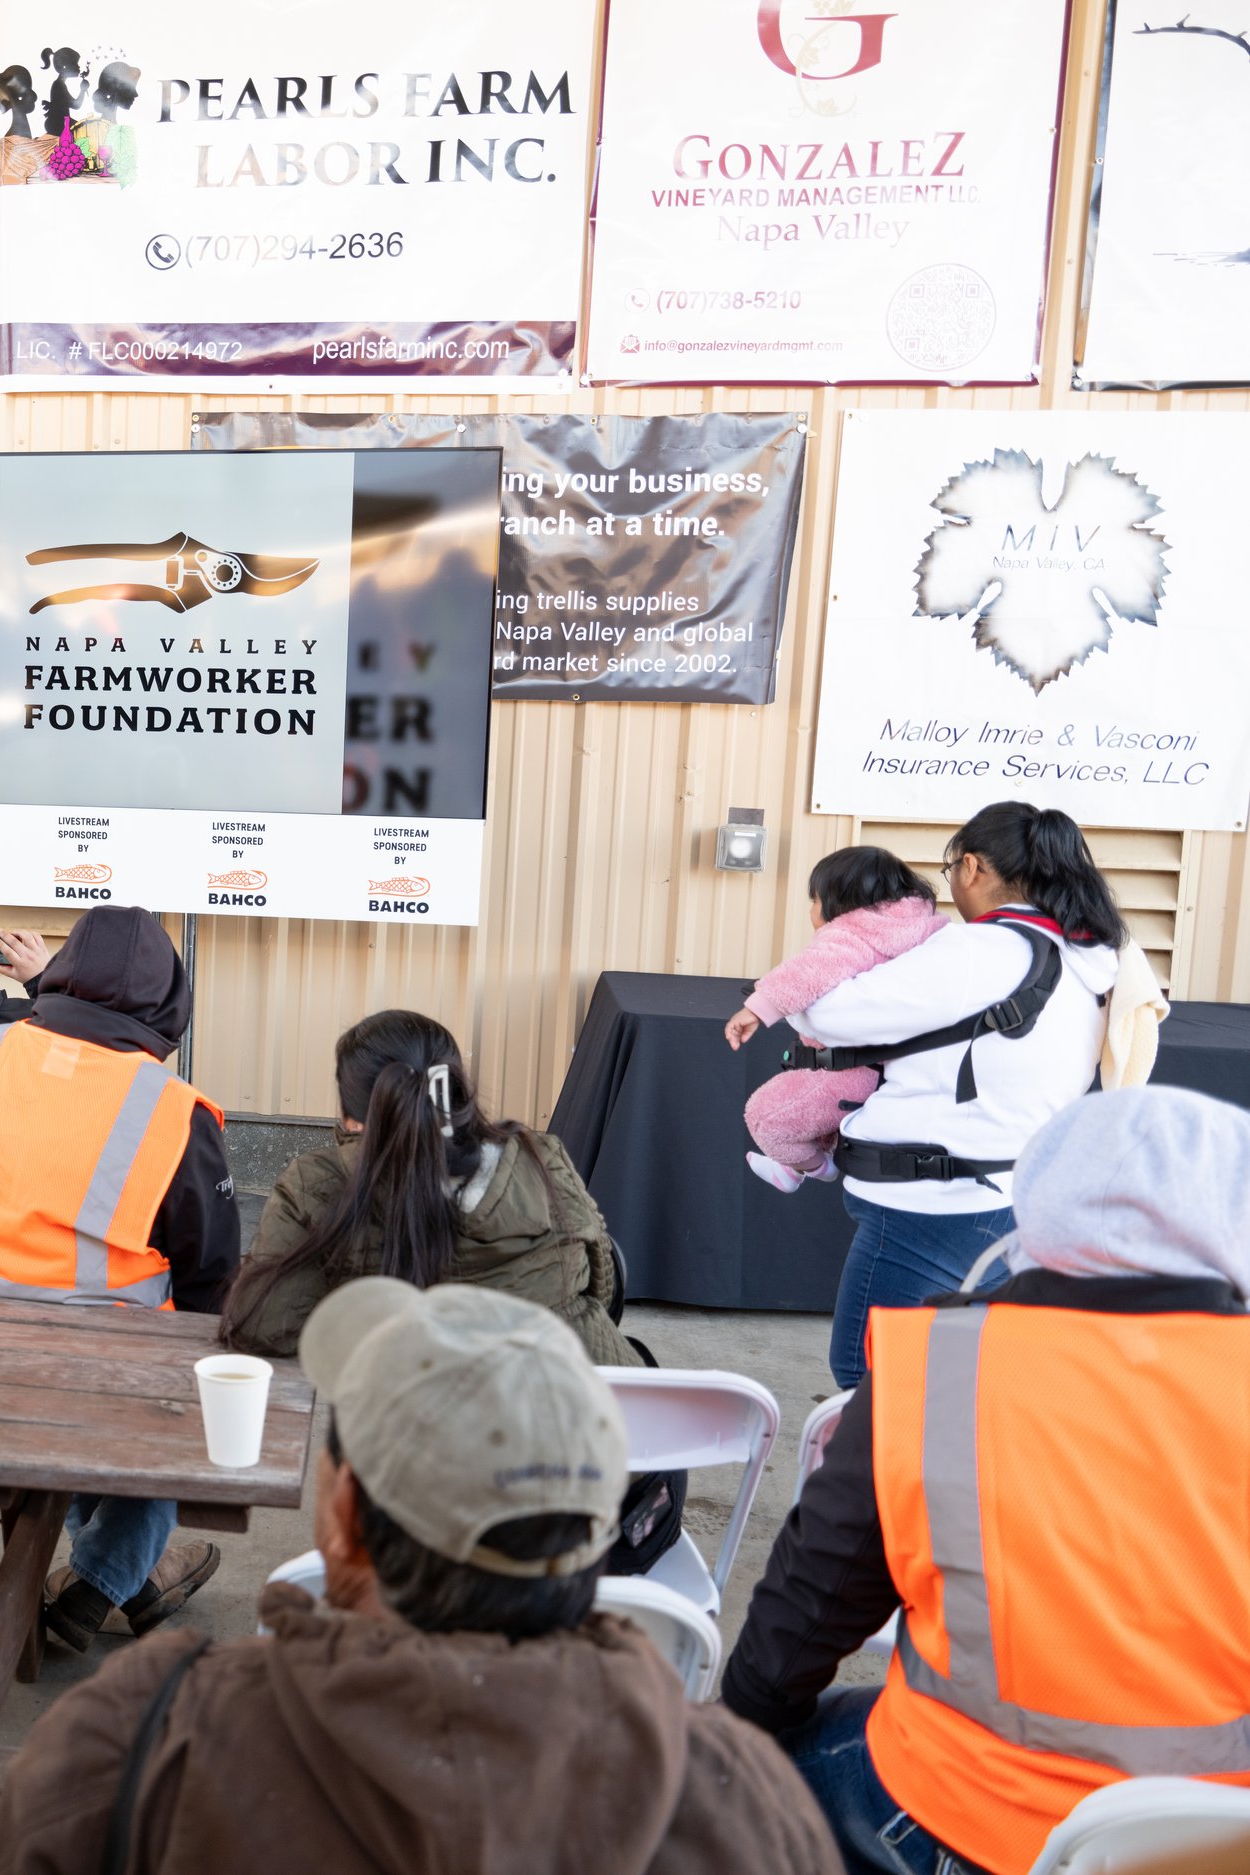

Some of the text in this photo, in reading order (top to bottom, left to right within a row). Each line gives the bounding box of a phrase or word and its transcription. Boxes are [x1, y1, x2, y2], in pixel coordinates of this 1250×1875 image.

[156, 69, 578, 123] PEARLS FARM
[193, 137, 556, 188] LABOR INC.
[673, 131, 966, 181] GONZALEZ
[651, 187, 770, 207] VINEYARD
[777, 185, 944, 207] MANAGEMENT
[715, 214, 911, 250] Napa Valley
[185, 231, 404, 268] (707)294-2636
[656, 289, 802, 314] (707)738-5210
[16, 341, 243, 360] LIC. # FLC000214972
[312, 335, 510, 364] pearlsfarminc.com
[644, 339, 843, 354] info@gonzalezvineyardmgmt.com
[502, 467, 770, 498] ing your business,
[586, 511, 615, 536] at
[625, 517, 642, 536] a
[653, 510, 725, 536] time.
[992, 556, 1029, 569] Napa
[1083, 557, 1105, 570] CA
[496, 589, 699, 615] ing trellis supplies
[496, 621, 753, 646] Napa Valley and global
[25, 637, 317, 655] NAPA VALLEY
[522, 652, 598, 672] market
[607, 653, 667, 673] since
[675, 654, 737, 673] 2002.
[24, 665, 317, 695] FARMWORKER
[23, 704, 316, 735] FOUNDATION
[879, 718, 1200, 751] Malloy Imrie & Vasconi
[862, 750, 1210, 786] Insurance Services, LLC
[58, 817, 110, 826] LIVESTREAM
[212, 822, 266, 832] LIVESTREAM
[58, 830, 108, 840] SPONSORED
[212, 836, 264, 845] SPONSORED
[374, 828, 429, 838] LIVESTREAM
[77, 844, 89, 852] BY
[232, 850, 244, 858] BY
[373, 842, 427, 851] SPONSORED
[394, 856, 406, 865] BY
[55, 886, 112, 900] BAHCO
[208, 893, 267, 907] BAHCO
[368, 900, 429, 914] BAHCO
